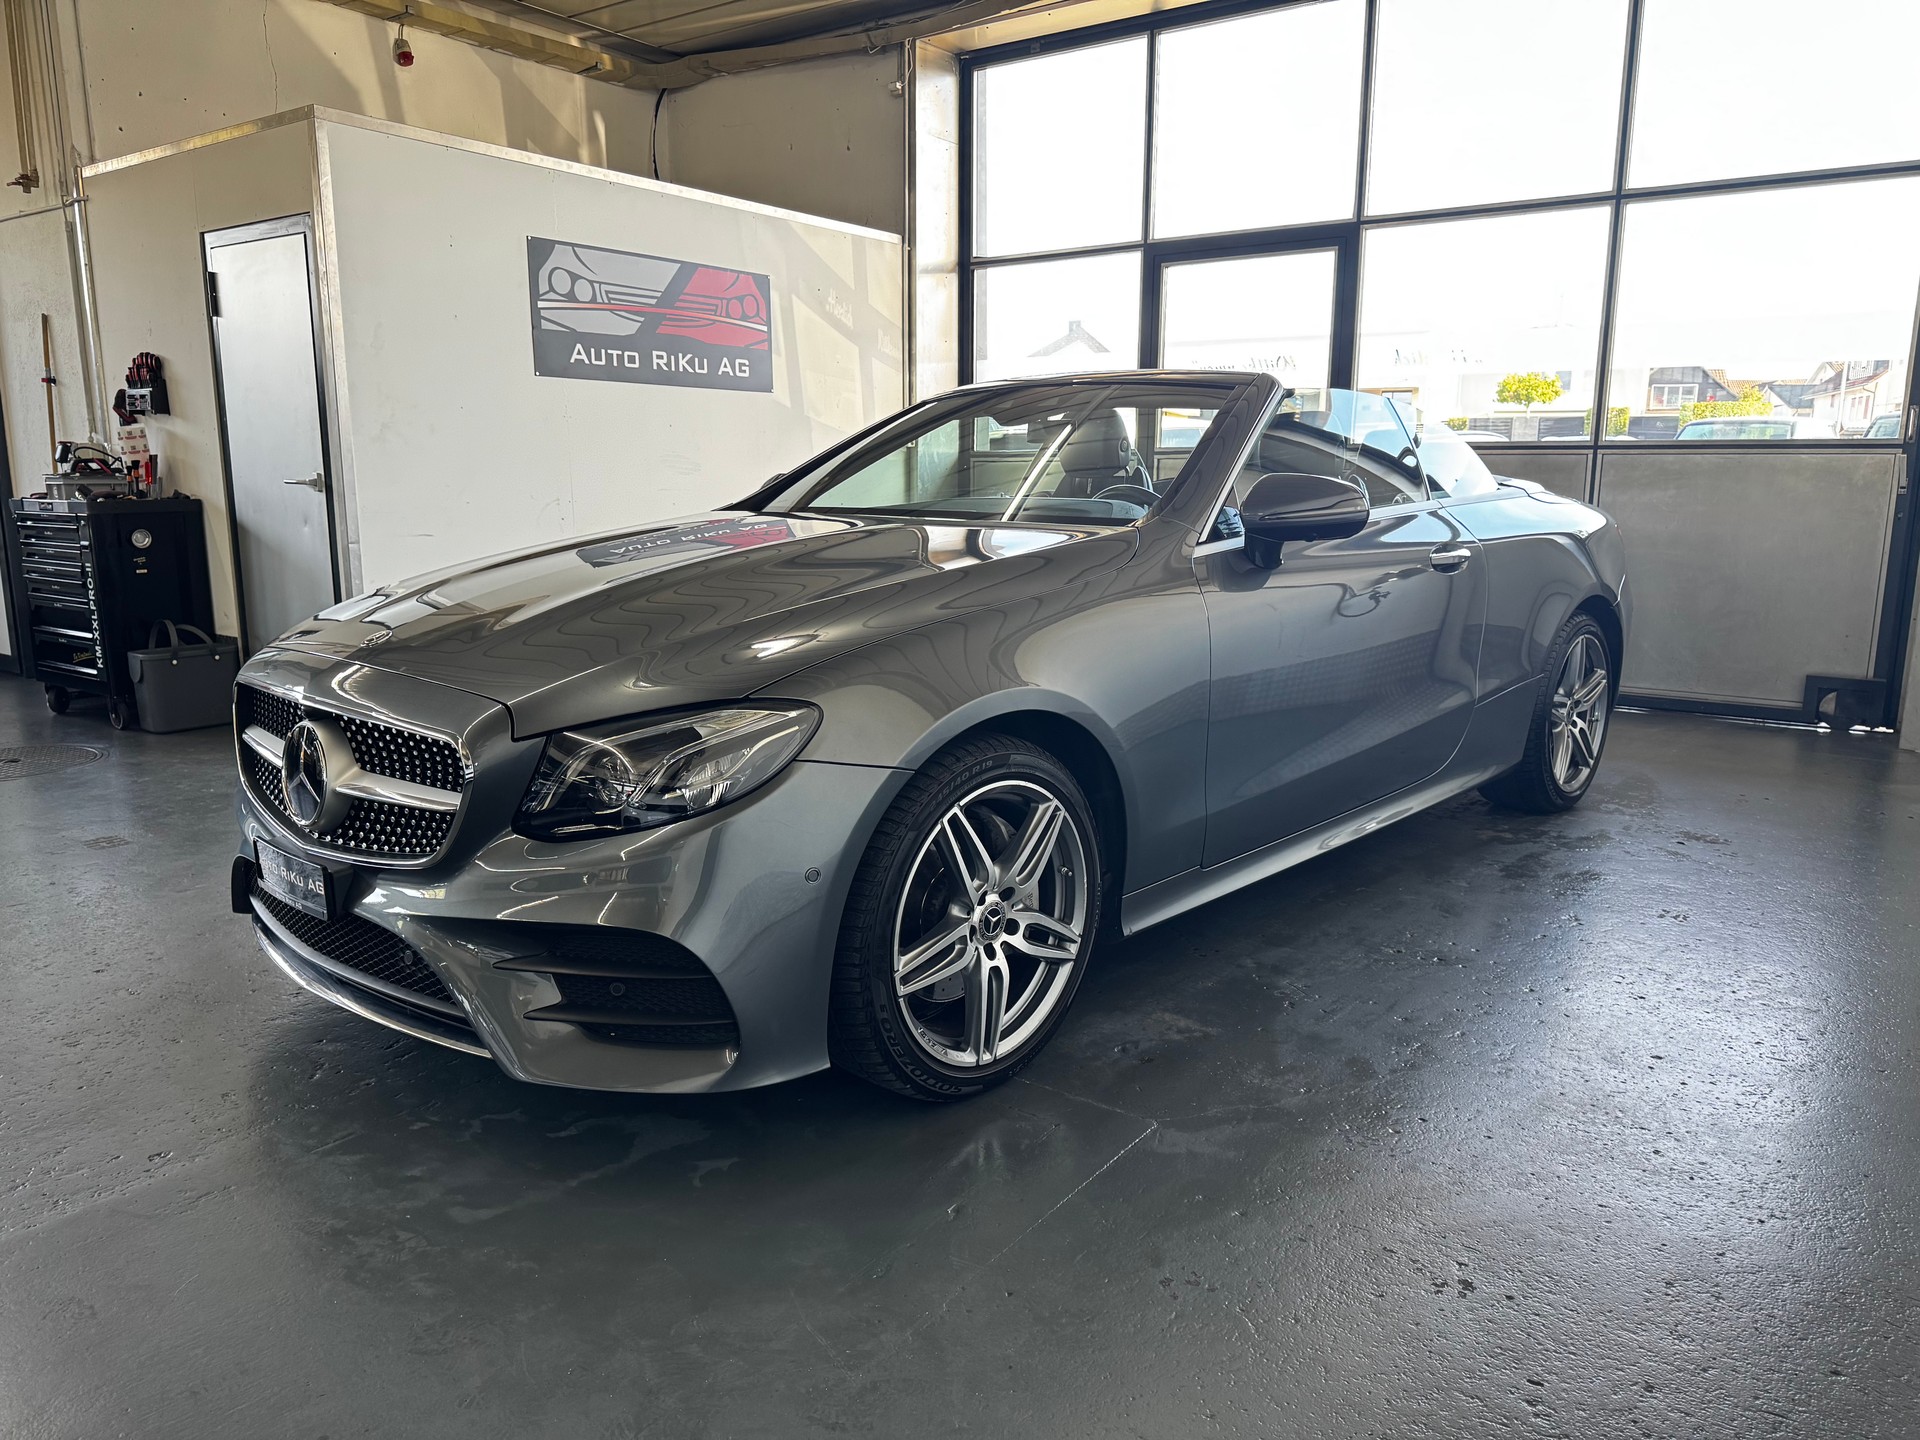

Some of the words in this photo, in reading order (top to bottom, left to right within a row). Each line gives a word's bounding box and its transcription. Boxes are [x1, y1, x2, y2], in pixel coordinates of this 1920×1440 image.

[570, 343, 639, 368] AUTO
[718, 357, 750, 377] AG
[308, 878, 324, 894] AG
